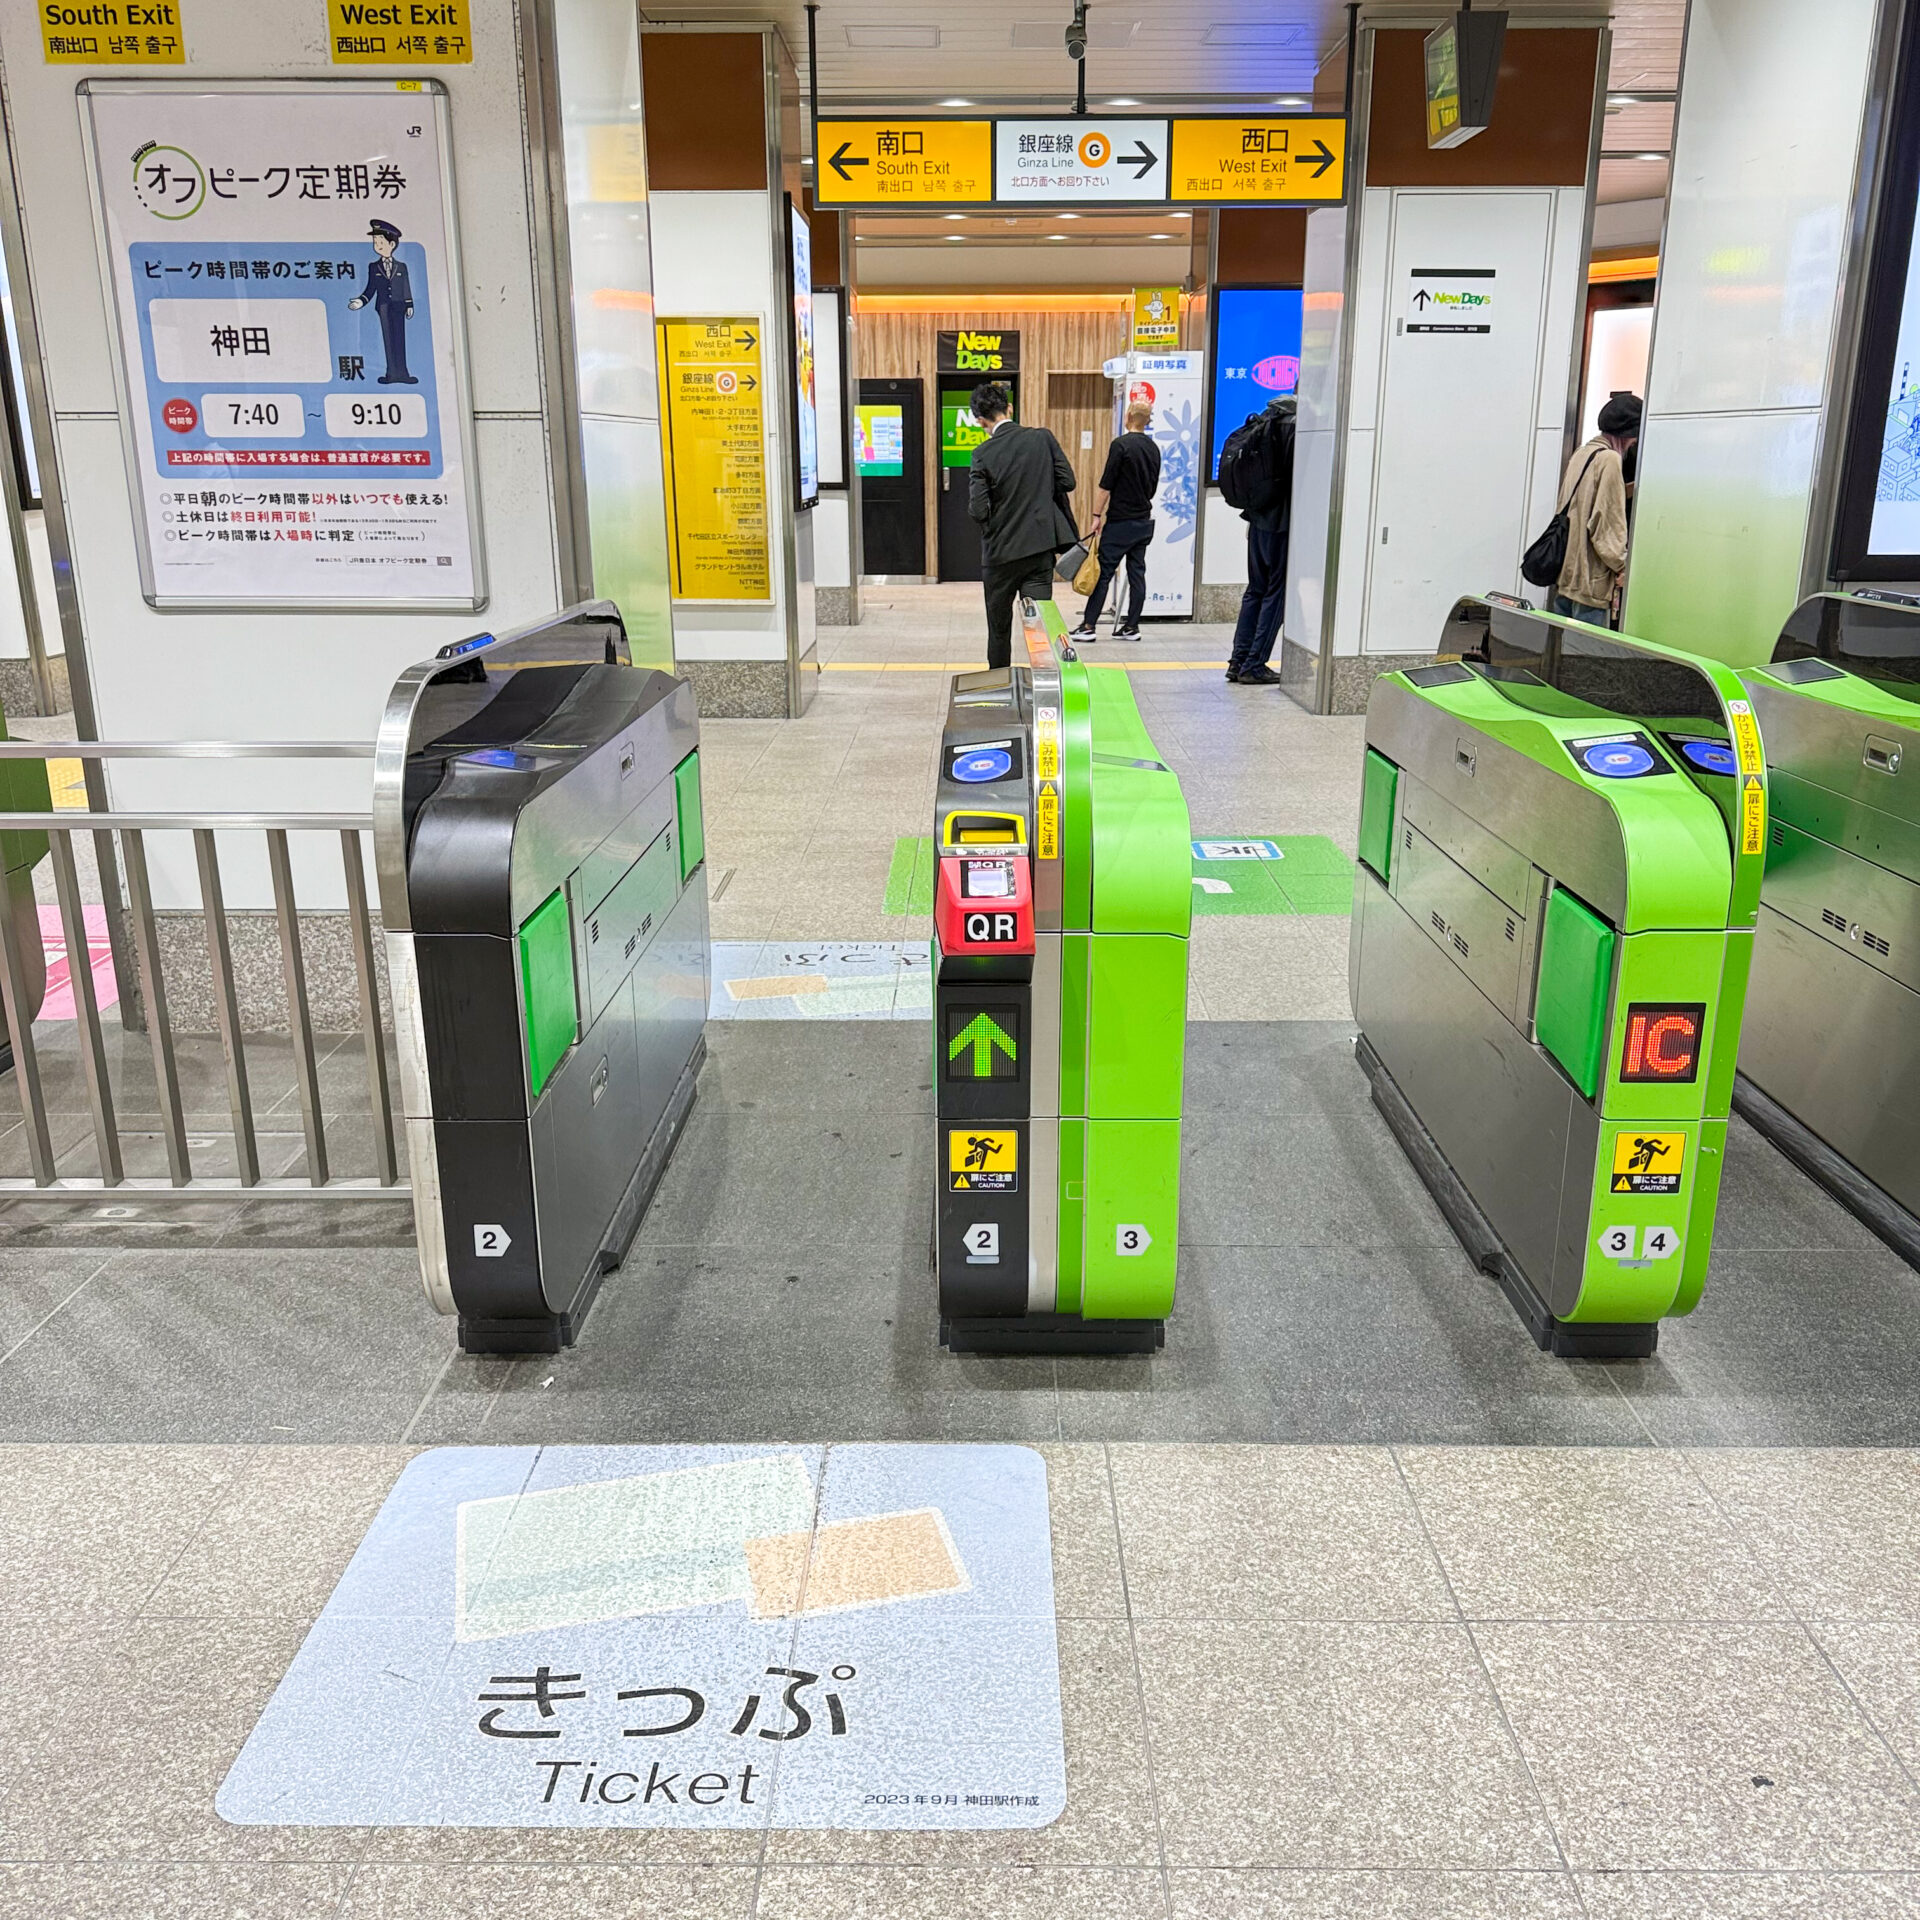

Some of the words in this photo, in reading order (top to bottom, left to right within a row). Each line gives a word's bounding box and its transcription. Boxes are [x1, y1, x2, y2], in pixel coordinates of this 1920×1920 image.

[46, 4, 118, 25] South
[126, 4, 175, 26] Exit
[340, 4, 402, 25] West
[410, 4, 458, 25] Exit
[48, 36, 99, 55] 南出口
[108, 36, 141, 55] 남쪽
[145, 36, 178, 55] 출구
[336, 36, 386, 54] 西出口
[396, 36, 429, 55] 서쪽
[433, 36, 466, 55] 출구
[400, 82, 417, 91] C-7
[406, 126, 422, 135] JR
[876, 130, 923, 155] 南口
[1017, 134, 1074, 155] 銀座線
[1088, 142, 1101, 158] G
[1241, 128, 1288, 154] 西口
[876, 160, 920, 176] South
[923, 160, 950, 176] Exit
[1017, 157, 1047, 169] Ginza
[1051, 157, 1074, 169] Line
[1218, 158, 1258, 174] West
[1262, 158, 1287, 174] Exit
[143, 164, 407, 203] オフピーク定期券
[876, 180, 913, 193] 南出口
[922, 180, 947, 193] 남쪽
[952, 180, 977, 193] 출구
[1011, 175, 1110, 188] 北口方面へお回り下さい
[1186, 178, 1223, 192] 西出口
[1232, 178, 1257, 192] 서쪽
[1262, 178, 1287, 192] 출구
[144, 259, 357, 281] ピーク時間帯のご案内
[1433, 291, 1492, 306] NewDays
[706, 324, 732, 338] 西口
[210, 325, 272, 357] 神田
[695, 340, 715, 349] West
[717, 340, 731, 349] Exit
[957, 331, 1002, 351] New
[337, 355, 365, 382] 駅
[956, 350, 1003, 371] Days
[1142, 359, 1187, 370] 証明写真
[682, 372, 714, 385] 銀座線
[1224, 367, 1247, 379] 東京
[680, 385, 700, 394] Ginza
[700, 385, 715, 394] Line
[168, 406, 192, 415] ピーク
[228, 403, 280, 425] 7:40
[351, 402, 402, 425] 9:10
[1736, 713, 1759, 772] かけこみ禁止
[1041, 799, 1055, 857] 扉にご注意
[1746, 793, 1760, 851] 扉にご注意
[967, 913, 1014, 941] QR
[1626, 1015, 1695, 1074] IC
[970, 1173, 1013, 1183] 扉にご注意
[1632, 1175, 1677, 1185] 扉にご注意
[482, 1231, 498, 1250] 2
[977, 1230, 992, 1249] 2
[1123, 1230, 1139, 1249] 3
[1610, 1232, 1627, 1252] 3
[1650, 1232, 1666, 1252] 4
[478, 1665, 856, 1740] きっぷ
[535, 1760, 761, 1804] Ticket
[964, 1794, 1041, 1807] 神田駅作成
